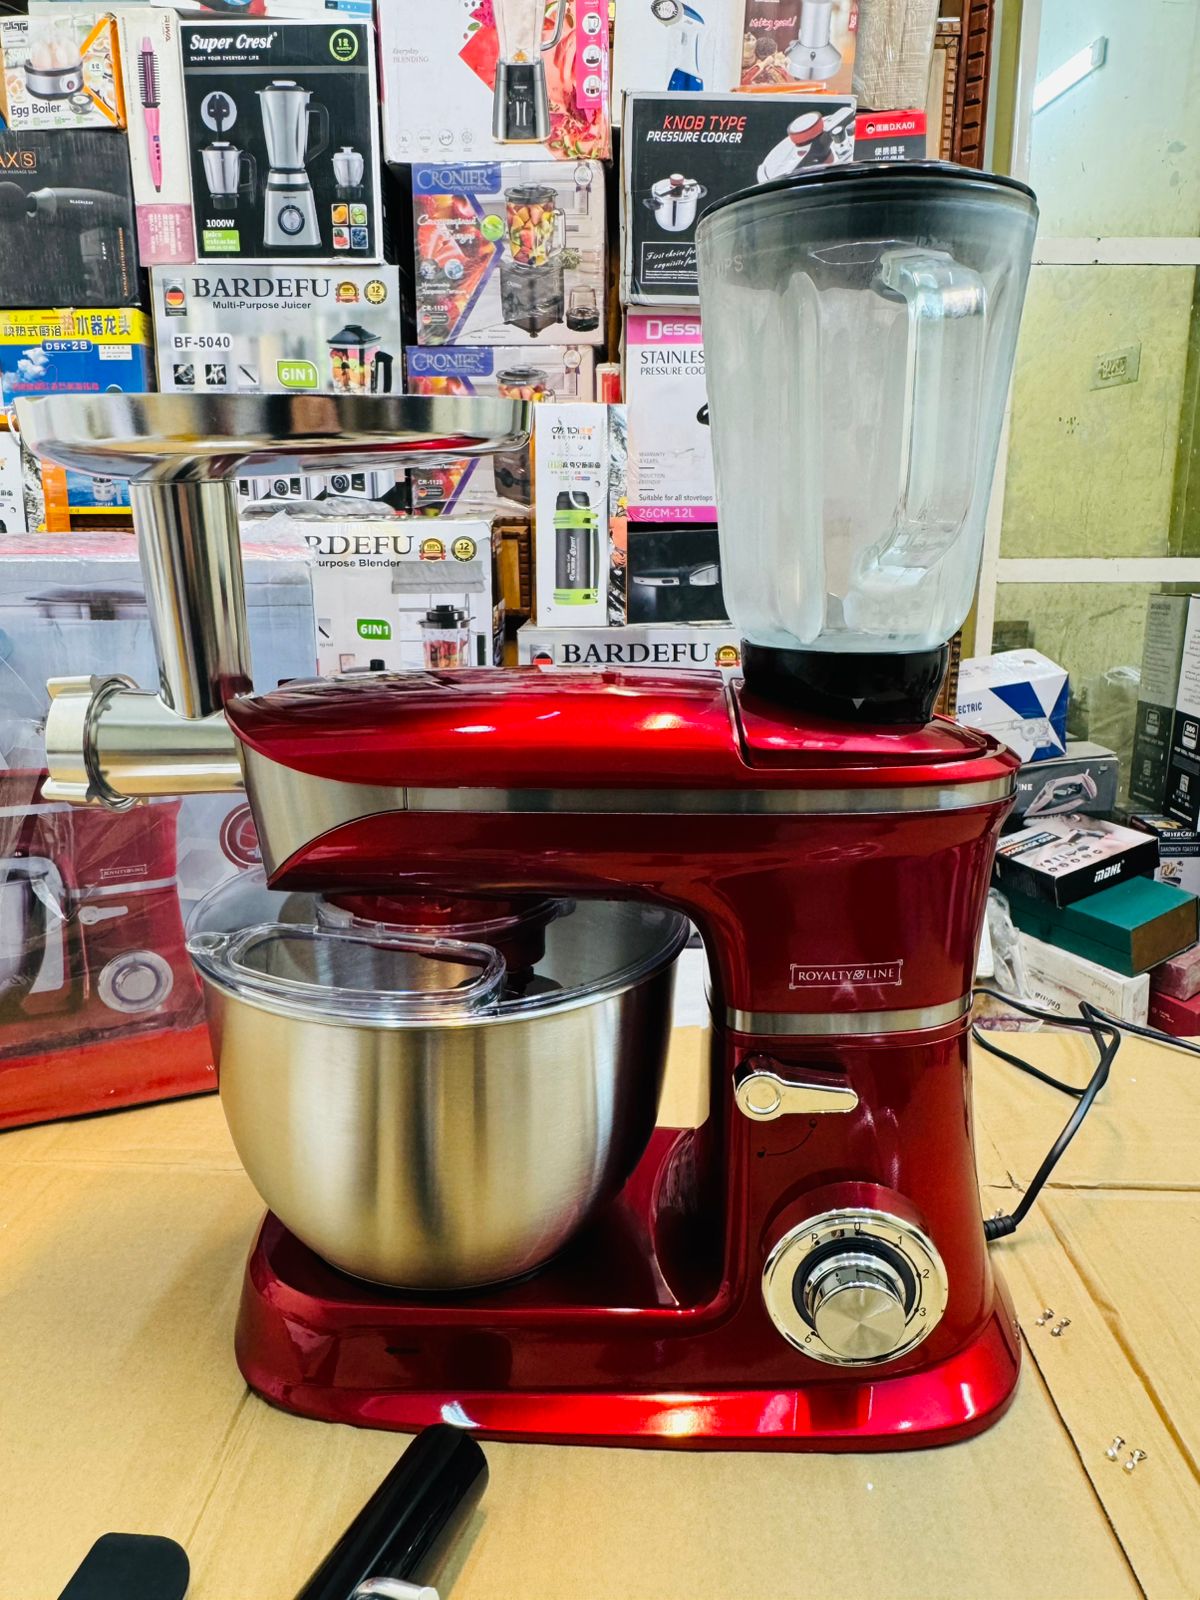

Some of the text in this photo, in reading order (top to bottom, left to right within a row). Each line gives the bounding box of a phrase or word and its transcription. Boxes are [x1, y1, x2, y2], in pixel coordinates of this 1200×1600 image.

[190, 33, 273, 53] Super Crest
[11, 102, 61, 117] Egg Boiler
[663, 115, 747, 131] KNOB TYPE
[646, 131, 743, 143] PRESSURE COOKER
[417, 169, 491, 190] CRONIER
[206, 219, 235, 228] 1000W
[645, 252, 665, 260] First
[192, 278, 331, 298] BARDEFU
[213, 301, 312, 310] Multi-Purpose Juicer
[646, 320, 703, 340] DESSI
[45, 341, 88, 350] DSK-28
[174, 336, 230, 349] BF-5040
[412, 353, 484, 372] CRONIER
[640, 350, 705, 365] STAINLES
[281, 369, 315, 381] 6IN1
[640, 366, 706, 376] PRESSURE COO
[638, 493, 663, 502] Suitable
[683, 494, 714, 502] stovetops
[639, 508, 696, 519] 26CM-12L
[305, 535, 415, 555] RDEFU
[459, 542, 470, 550] 12
[316, 559, 400, 569] urpose Blender
[360, 624, 390, 636] 6IN1
[562, 643, 710, 665] BARDEFU
[956, 702, 983, 715] ECTRIC
[798, 967, 895, 981] ROYALTY LINE
[922, 1269, 930, 1279] 2
[919, 1307, 927, 1316] 3
